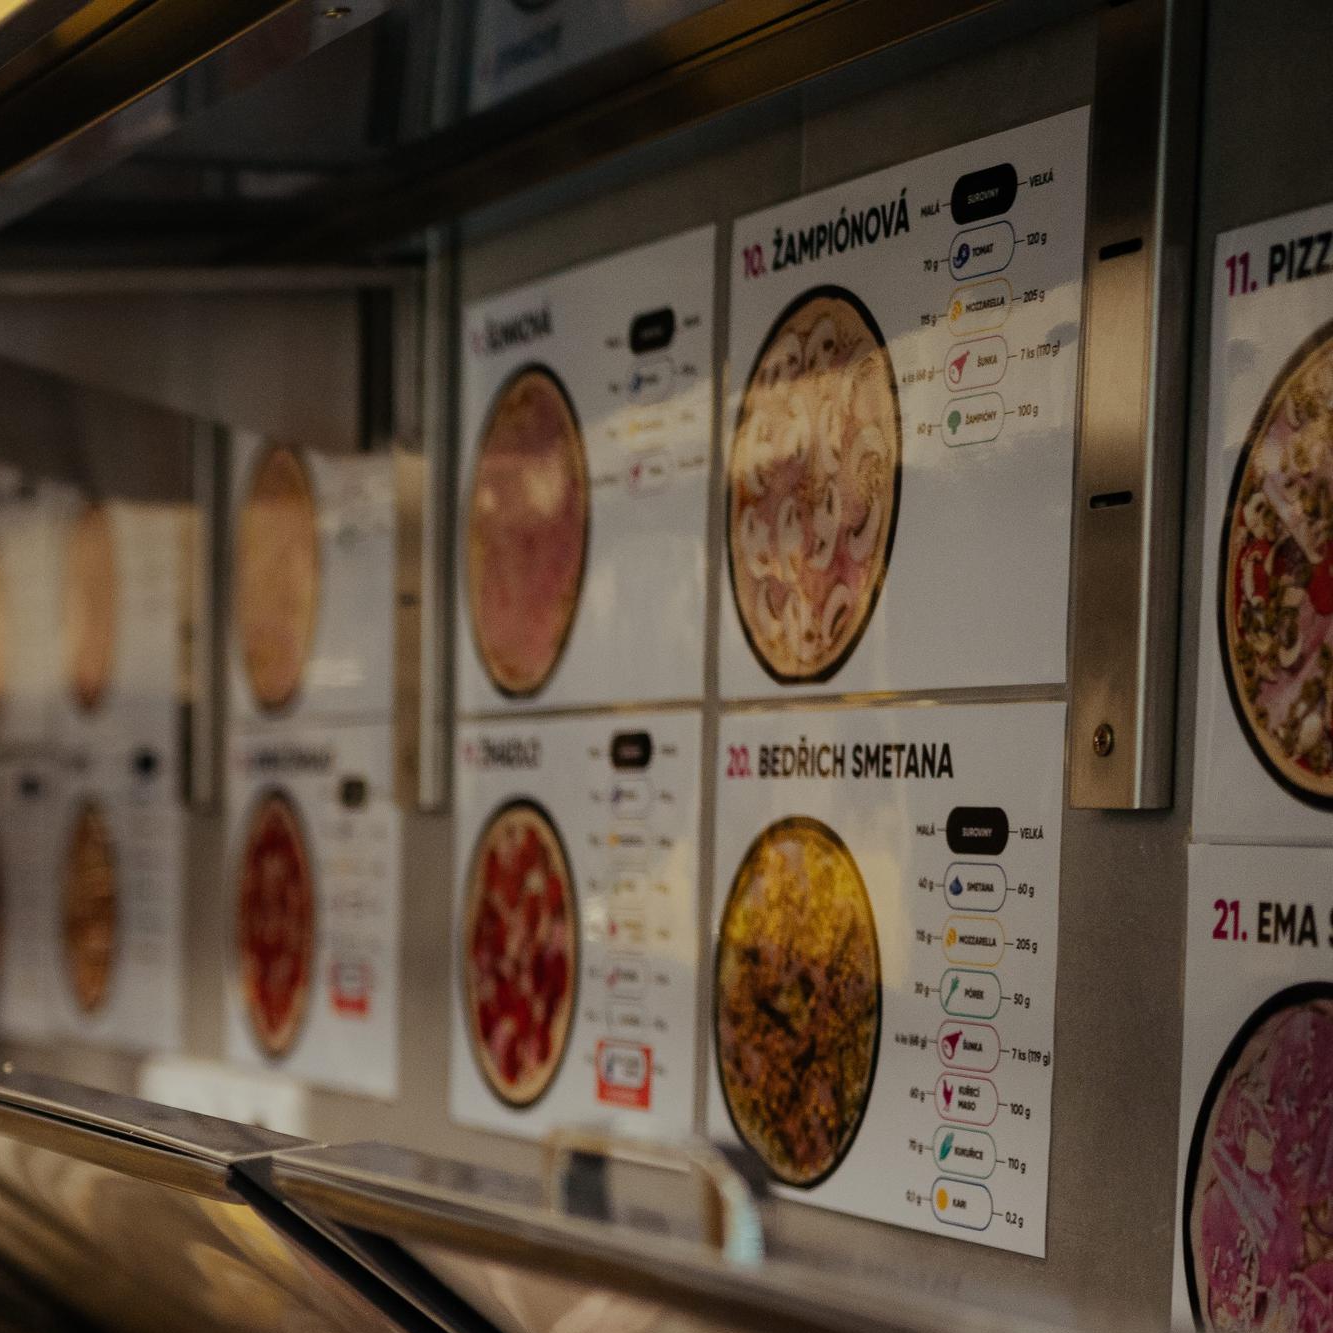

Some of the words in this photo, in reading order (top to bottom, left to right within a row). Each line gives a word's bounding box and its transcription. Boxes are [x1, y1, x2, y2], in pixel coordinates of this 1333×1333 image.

[1029, 167, 1054, 188] VELKÁ
[772, 187, 910, 272] ŽAMPIÓNOVÁ
[1026, 232, 1040, 245] 120
[972, 243, 994, 257] TOMAT
[1225, 251, 1257, 297] 11.
[1023, 289, 1038, 303] 205
[1027, 347, 1034, 359] ks
[1052, 340, 1061, 356] g)
[977, 355, 998, 367] ŠUNKA
[1018, 404, 1031, 417] 100
[758, 734, 845, 779] BEDŘICH
[852, 742, 954, 779] SMETANA
[1020, 825, 1044, 840] VELKÁ
[966, 882, 995, 893] SMETANA
[1017, 883, 1027, 895] 60
[1212, 898, 1248, 942] 21.
[1257, 902, 1318, 948] EMA
[1016, 938, 1030, 950] 205
[1013, 993, 1023, 1005] 50
[962, 1039, 983, 1052] ŠUNKA
[1018, 1050, 1026, 1061] ks
[1043, 1051, 1051, 1067] g)
[1010, 1103, 1024, 1116] 100
[1007, 1157, 1019, 1170] 110
[952, 1198, 967, 1209] KARI
[1005, 1211, 1017, 1225] 0,2
